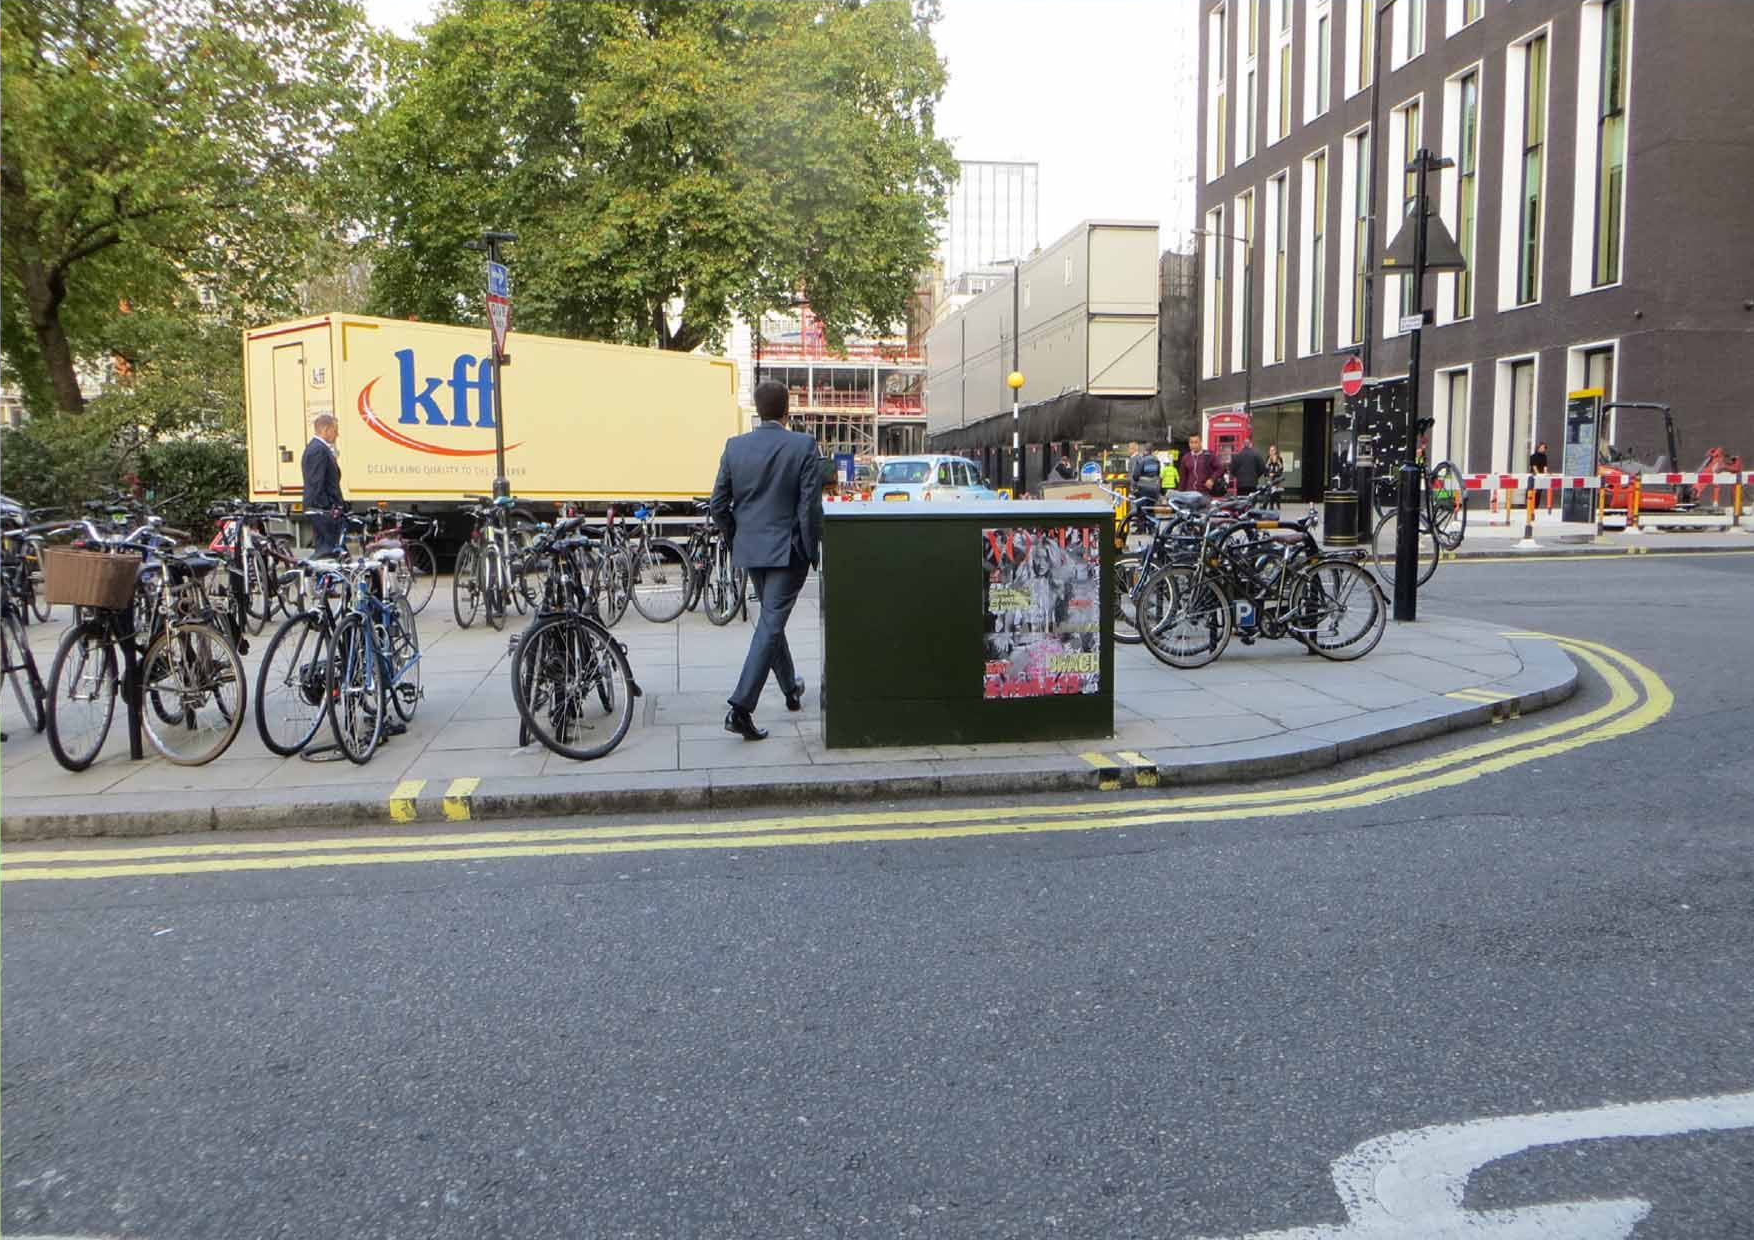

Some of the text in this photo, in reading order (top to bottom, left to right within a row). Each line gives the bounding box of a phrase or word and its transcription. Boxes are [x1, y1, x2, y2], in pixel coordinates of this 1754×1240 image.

[367, 463, 421, 475] DELIVERING
[423, 464, 460, 475] QUALITY
[461, 465, 472, 475] TO
[1236, 601, 1253, 625] P
